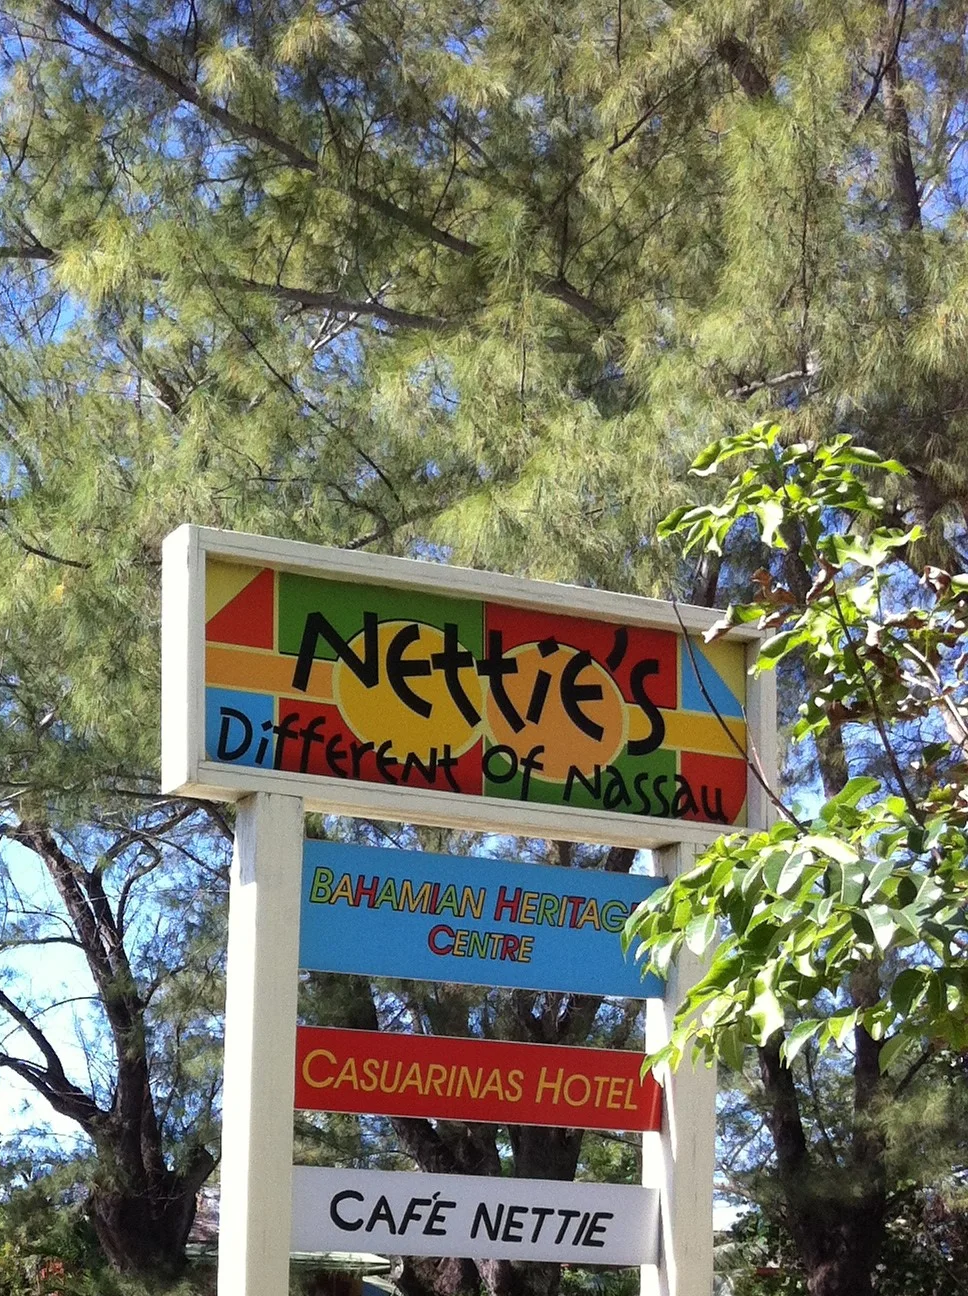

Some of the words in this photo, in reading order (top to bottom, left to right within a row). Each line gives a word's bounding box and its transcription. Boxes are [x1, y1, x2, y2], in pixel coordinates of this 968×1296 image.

[292, 611, 665, 756] Nettie's
[217, 707, 458, 793] Different
[562, 762, 730, 828] Nassau
[310, 867, 486, 919] BAHAMIAN
[495, 886, 640, 934] HERITAG
[428, 925, 534, 963] CENTRE
[302, 1049, 524, 1102] CASUARINAS
[535, 1067, 638, 1111] HOTEL
[330, 1190, 457, 1236] CAFÉ
[470, 1203, 614, 1248] NETTIE
